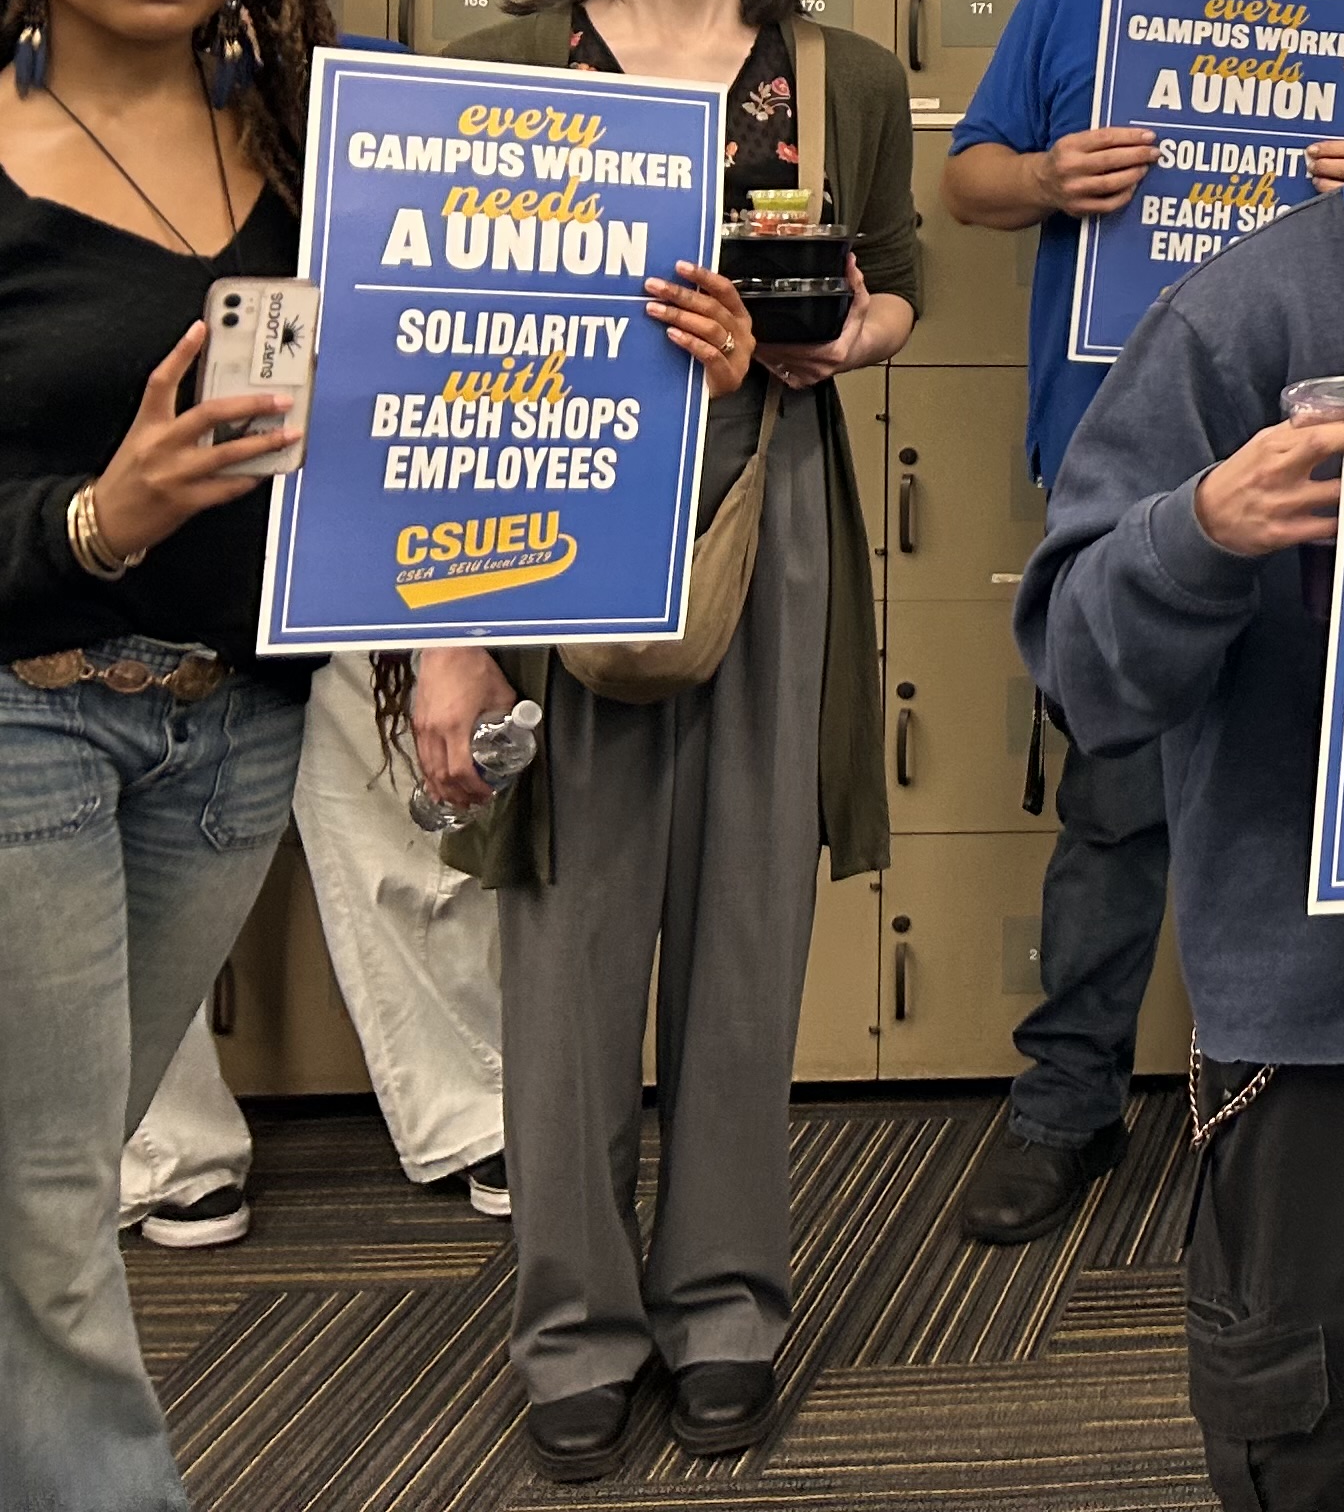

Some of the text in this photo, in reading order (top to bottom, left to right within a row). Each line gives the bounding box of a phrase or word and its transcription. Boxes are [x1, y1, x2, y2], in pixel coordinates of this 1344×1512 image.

[970, 2, 993, 14] 171
[1128, 15, 1252, 49] CAMPUS
[1189, 48, 1305, 83] needs
[1148, 69, 1338, 122] A UNION
[458, 103, 606, 149] every
[348, 131, 693, 189] CAMPUS WORKER
[442, 178, 605, 224] needs
[1141, 195, 1231, 230] BEACH
[1188, 171, 1280, 208] with
[381, 208, 648, 277] A UNION
[396, 308, 630, 359] SOLIDARITY
[260, 347, 278, 379] SURF
[443, 350, 573, 404] with
[372, 394, 640, 440] BEACH SHOPS
[383, 447, 617, 490] EMPLOYEES
[396, 511, 559, 566] CSUEU
[396, 551, 552, 583] CSEA SEIU Local 2579
